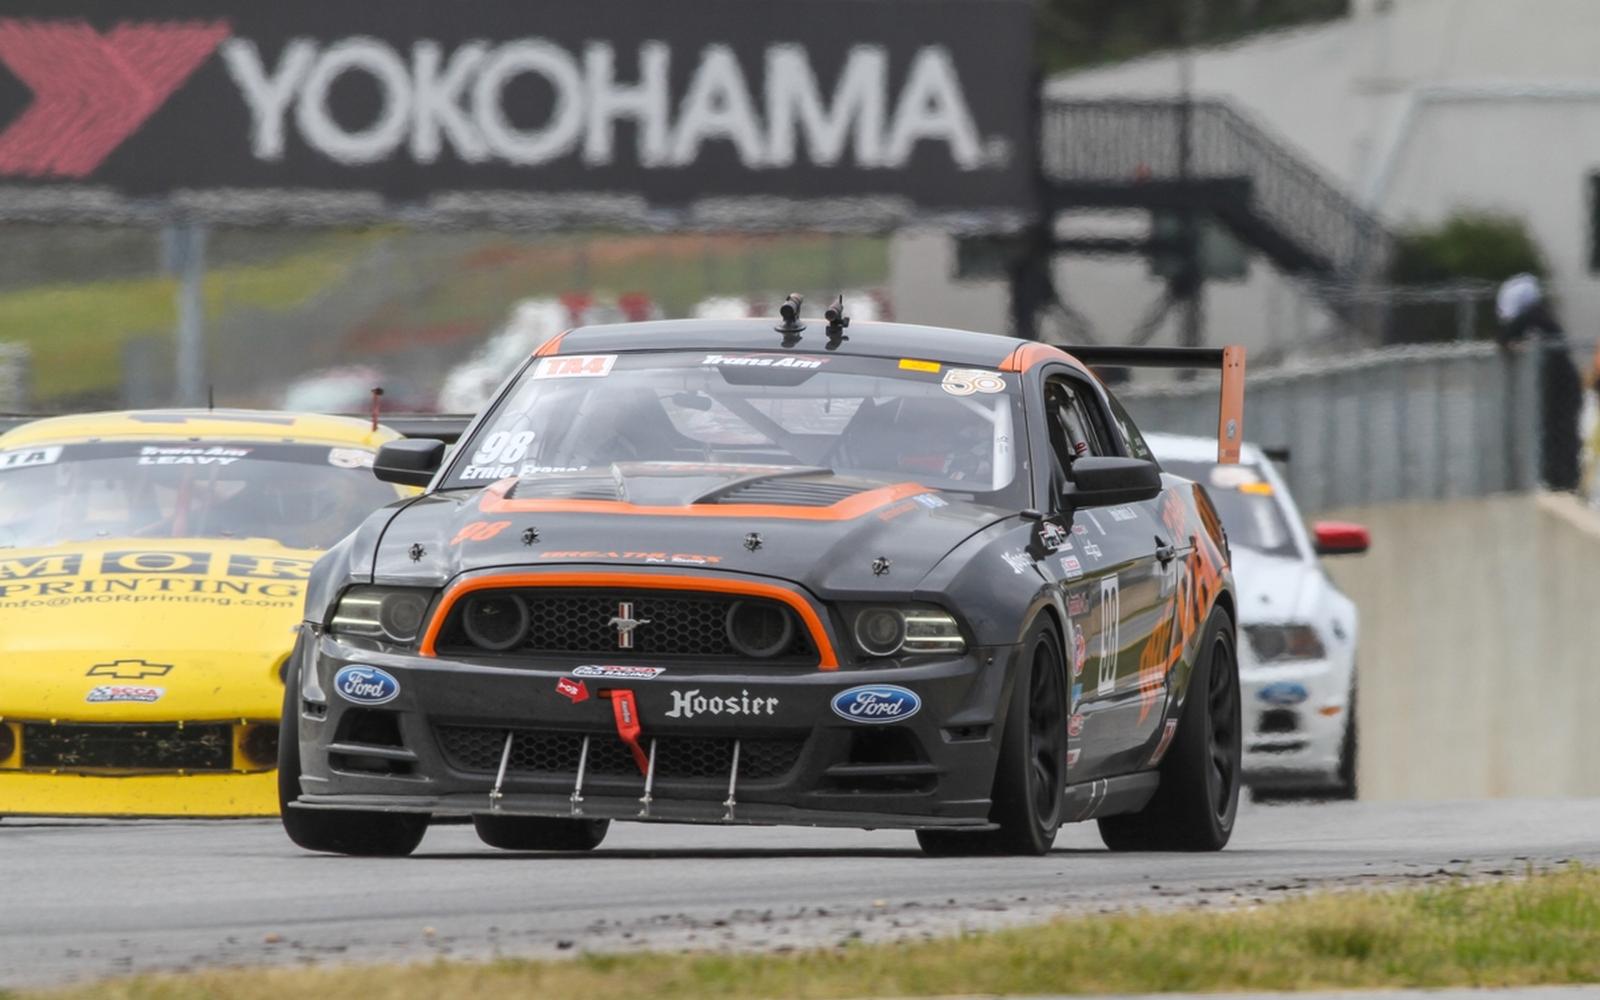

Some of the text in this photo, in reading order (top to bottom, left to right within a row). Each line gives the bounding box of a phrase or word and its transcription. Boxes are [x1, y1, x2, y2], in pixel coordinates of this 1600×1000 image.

[219, 36, 985, 170] YOKOHAMA
[546, 357, 607, 376] TA4
[702, 355, 821, 369] Trans Am
[472, 431, 535, 465] 98
[138, 456, 240, 465] LEAVY
[459, 464, 515, 480] Ernie
[0, 578, 299, 598] PRINTING
[344, 671, 384, 697] Ford
[665, 689, 779, 718] Hoosier
[849, 691, 904, 715] Ford
